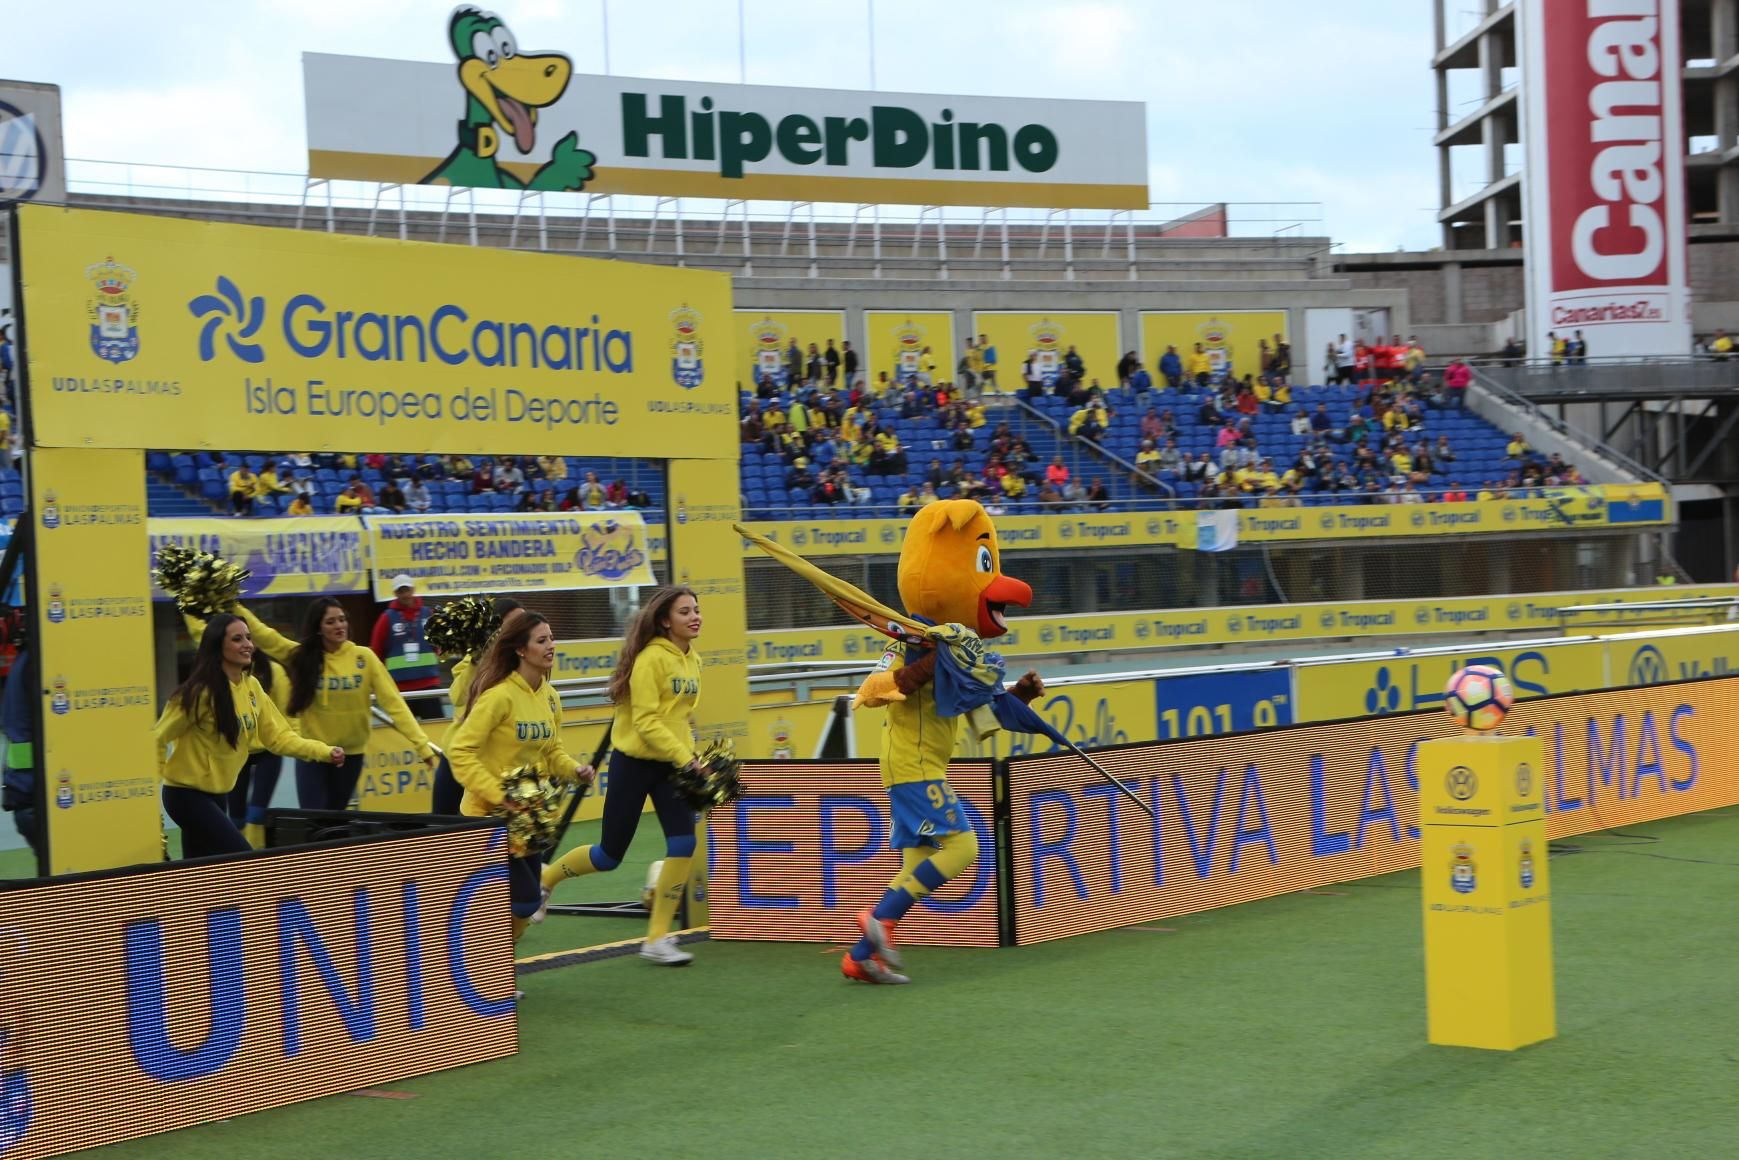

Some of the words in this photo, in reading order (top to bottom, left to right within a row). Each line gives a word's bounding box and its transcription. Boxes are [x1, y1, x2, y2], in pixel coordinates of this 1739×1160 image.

[620, 91, 1060, 179] HiperDino
[282, 294, 633, 374] GranCanaria
[246, 377, 297, 417] Isla
[305, 380, 441, 427] Europea
[450, 386, 498, 424] del
[506, 388, 619, 431] Deporte
[1248, 515, 1300, 532] Tropical
[1338, 513, 1391, 531] Tropical
[1428, 510, 1480, 526] Tropical
[380, 521, 460, 539] NUESTRO
[464, 519, 580, 537] SENTIMIENTO
[811, 527, 866, 547] Tropical
[1078, 522, 1131, 541] Tropical
[411, 541, 469, 561] HECHO
[475, 539, 556, 558] BANDERA
[1247, 614, 1301, 633] Tropical
[1340, 610, 1396, 628] Tropical
[1433, 606, 1489, 624] Tropical
[1059, 624, 1115, 644] Tropical
[1154, 619, 1208, 639] Tropical
[763, 640, 823, 663] Tropical
[556, 650, 618, 674] Tropical
